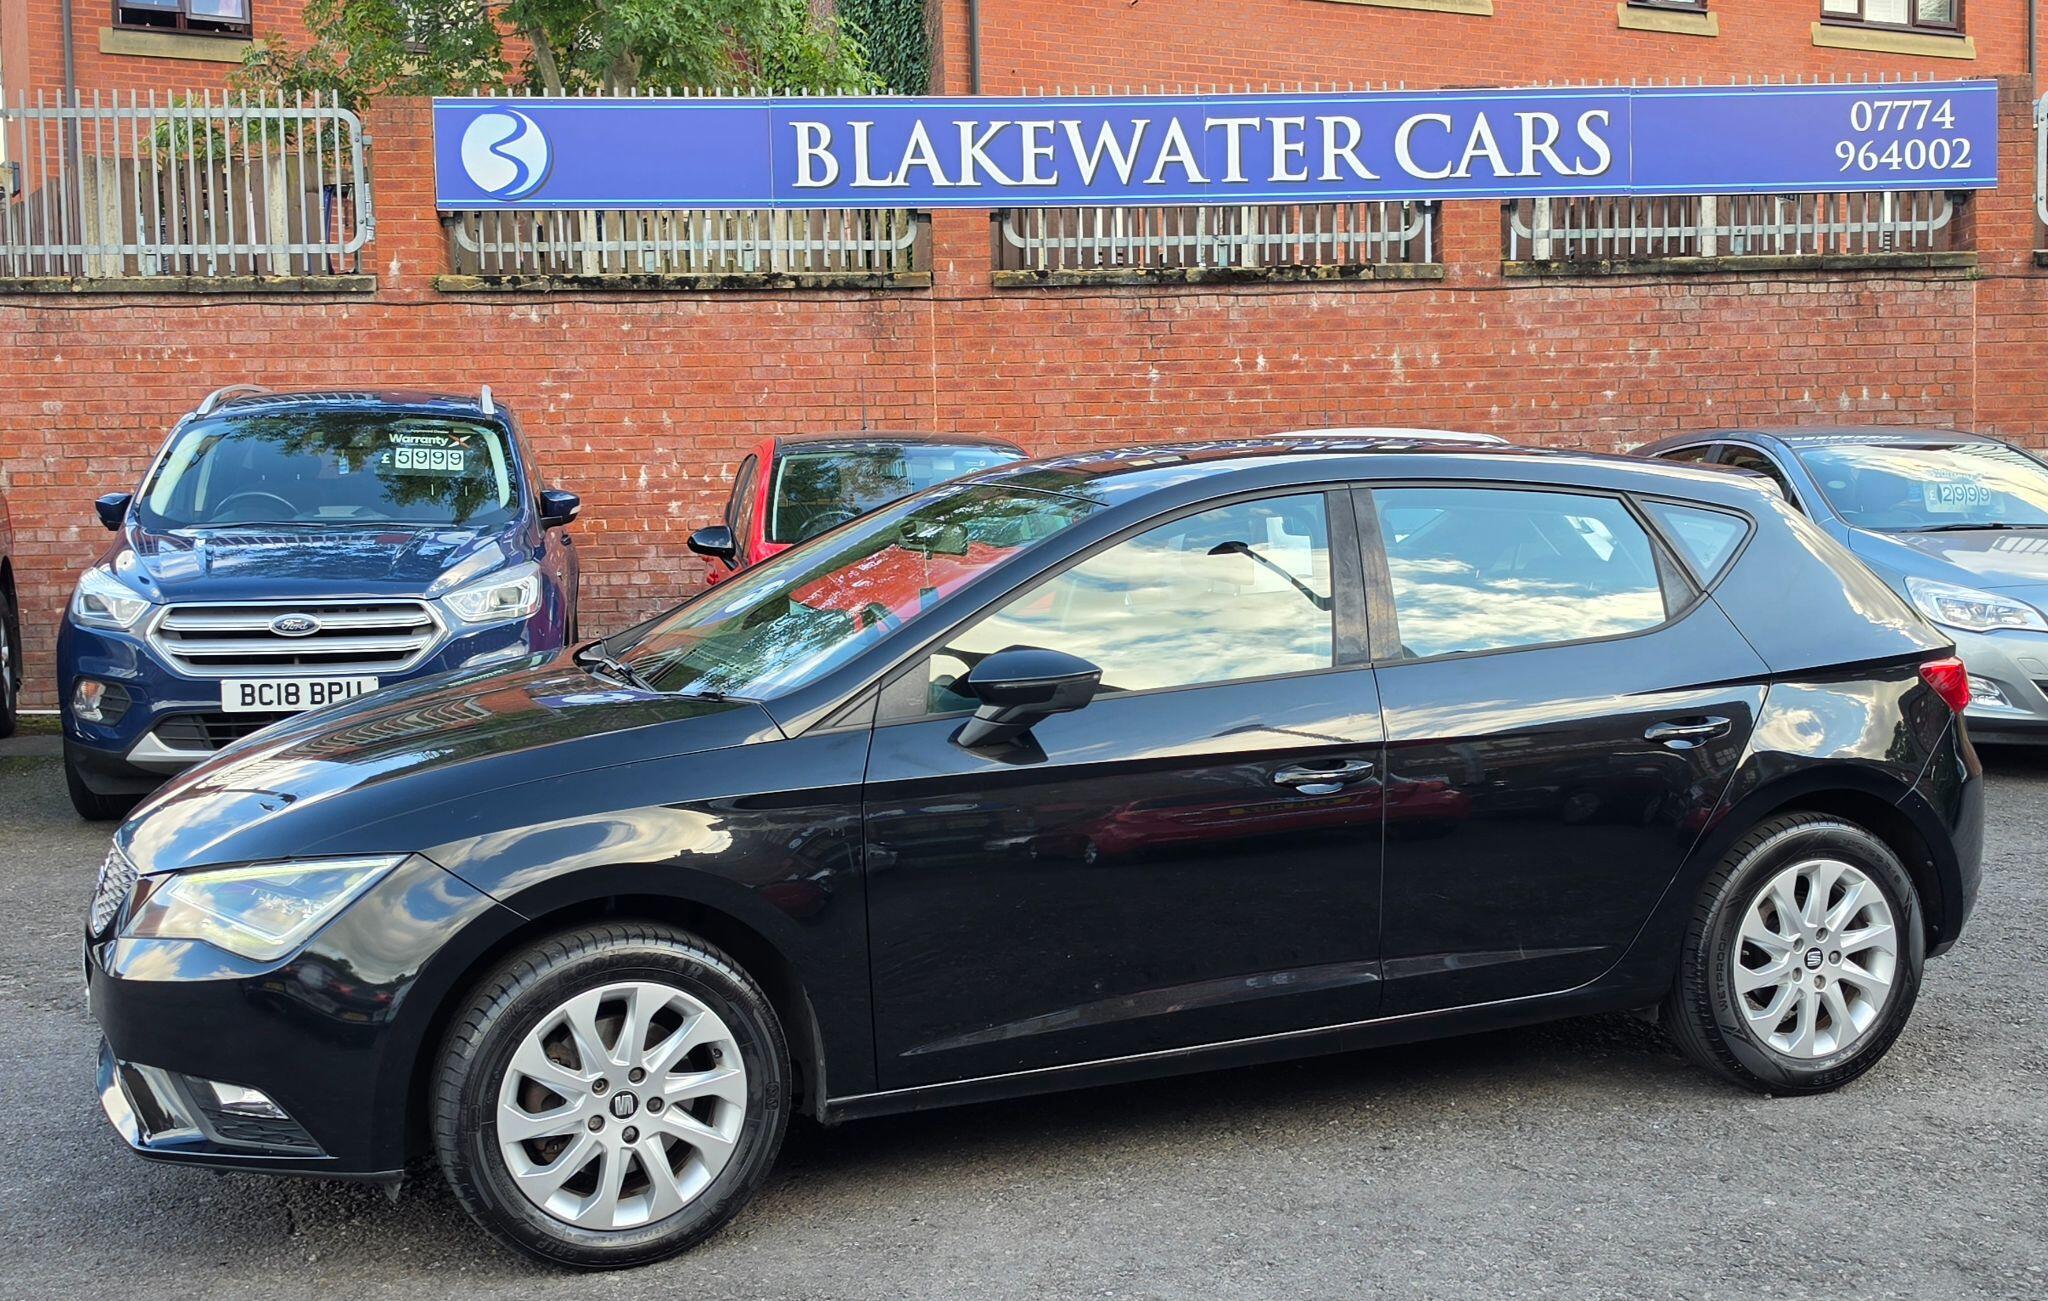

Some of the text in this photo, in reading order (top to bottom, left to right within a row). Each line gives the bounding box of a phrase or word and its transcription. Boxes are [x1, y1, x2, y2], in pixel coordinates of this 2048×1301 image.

[1850, 98, 1955, 132] 07774
[788, 109, 1612, 188] BLAKEWATER CARS
[1835, 137, 1972, 172] 964002
[380, 449, 463, 467] £ 5999
[1942, 486, 1990, 502] 2999
[281, 618, 309, 632] Ford
[240, 683, 300, 706] BC18
